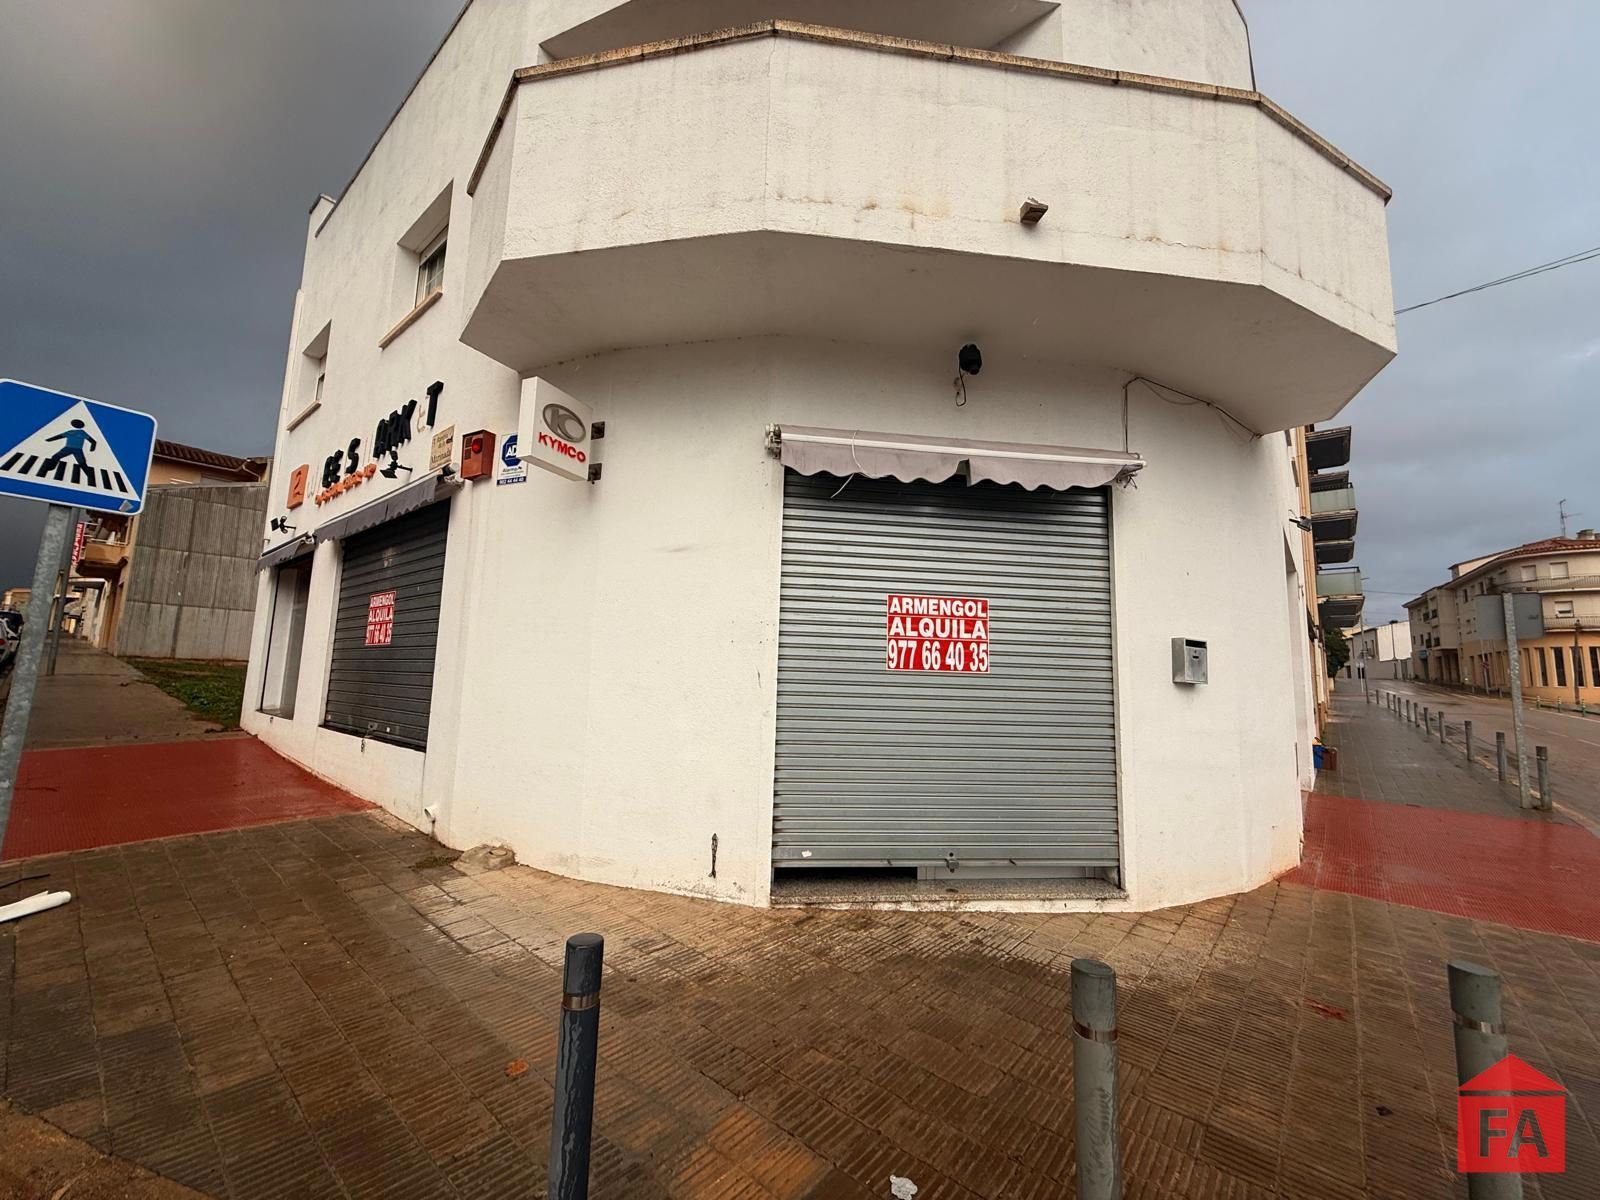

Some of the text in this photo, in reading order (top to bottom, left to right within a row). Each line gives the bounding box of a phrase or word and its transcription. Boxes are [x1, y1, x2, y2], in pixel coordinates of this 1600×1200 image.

[538, 431, 586, 463] KYMCO
[368, 606, 393, 623] ALQUILA
[889, 597, 987, 618] ARMENGOL
[889, 617, 987, 639] ALQUILA
[888, 639, 988, 672] 977 66 40 35
